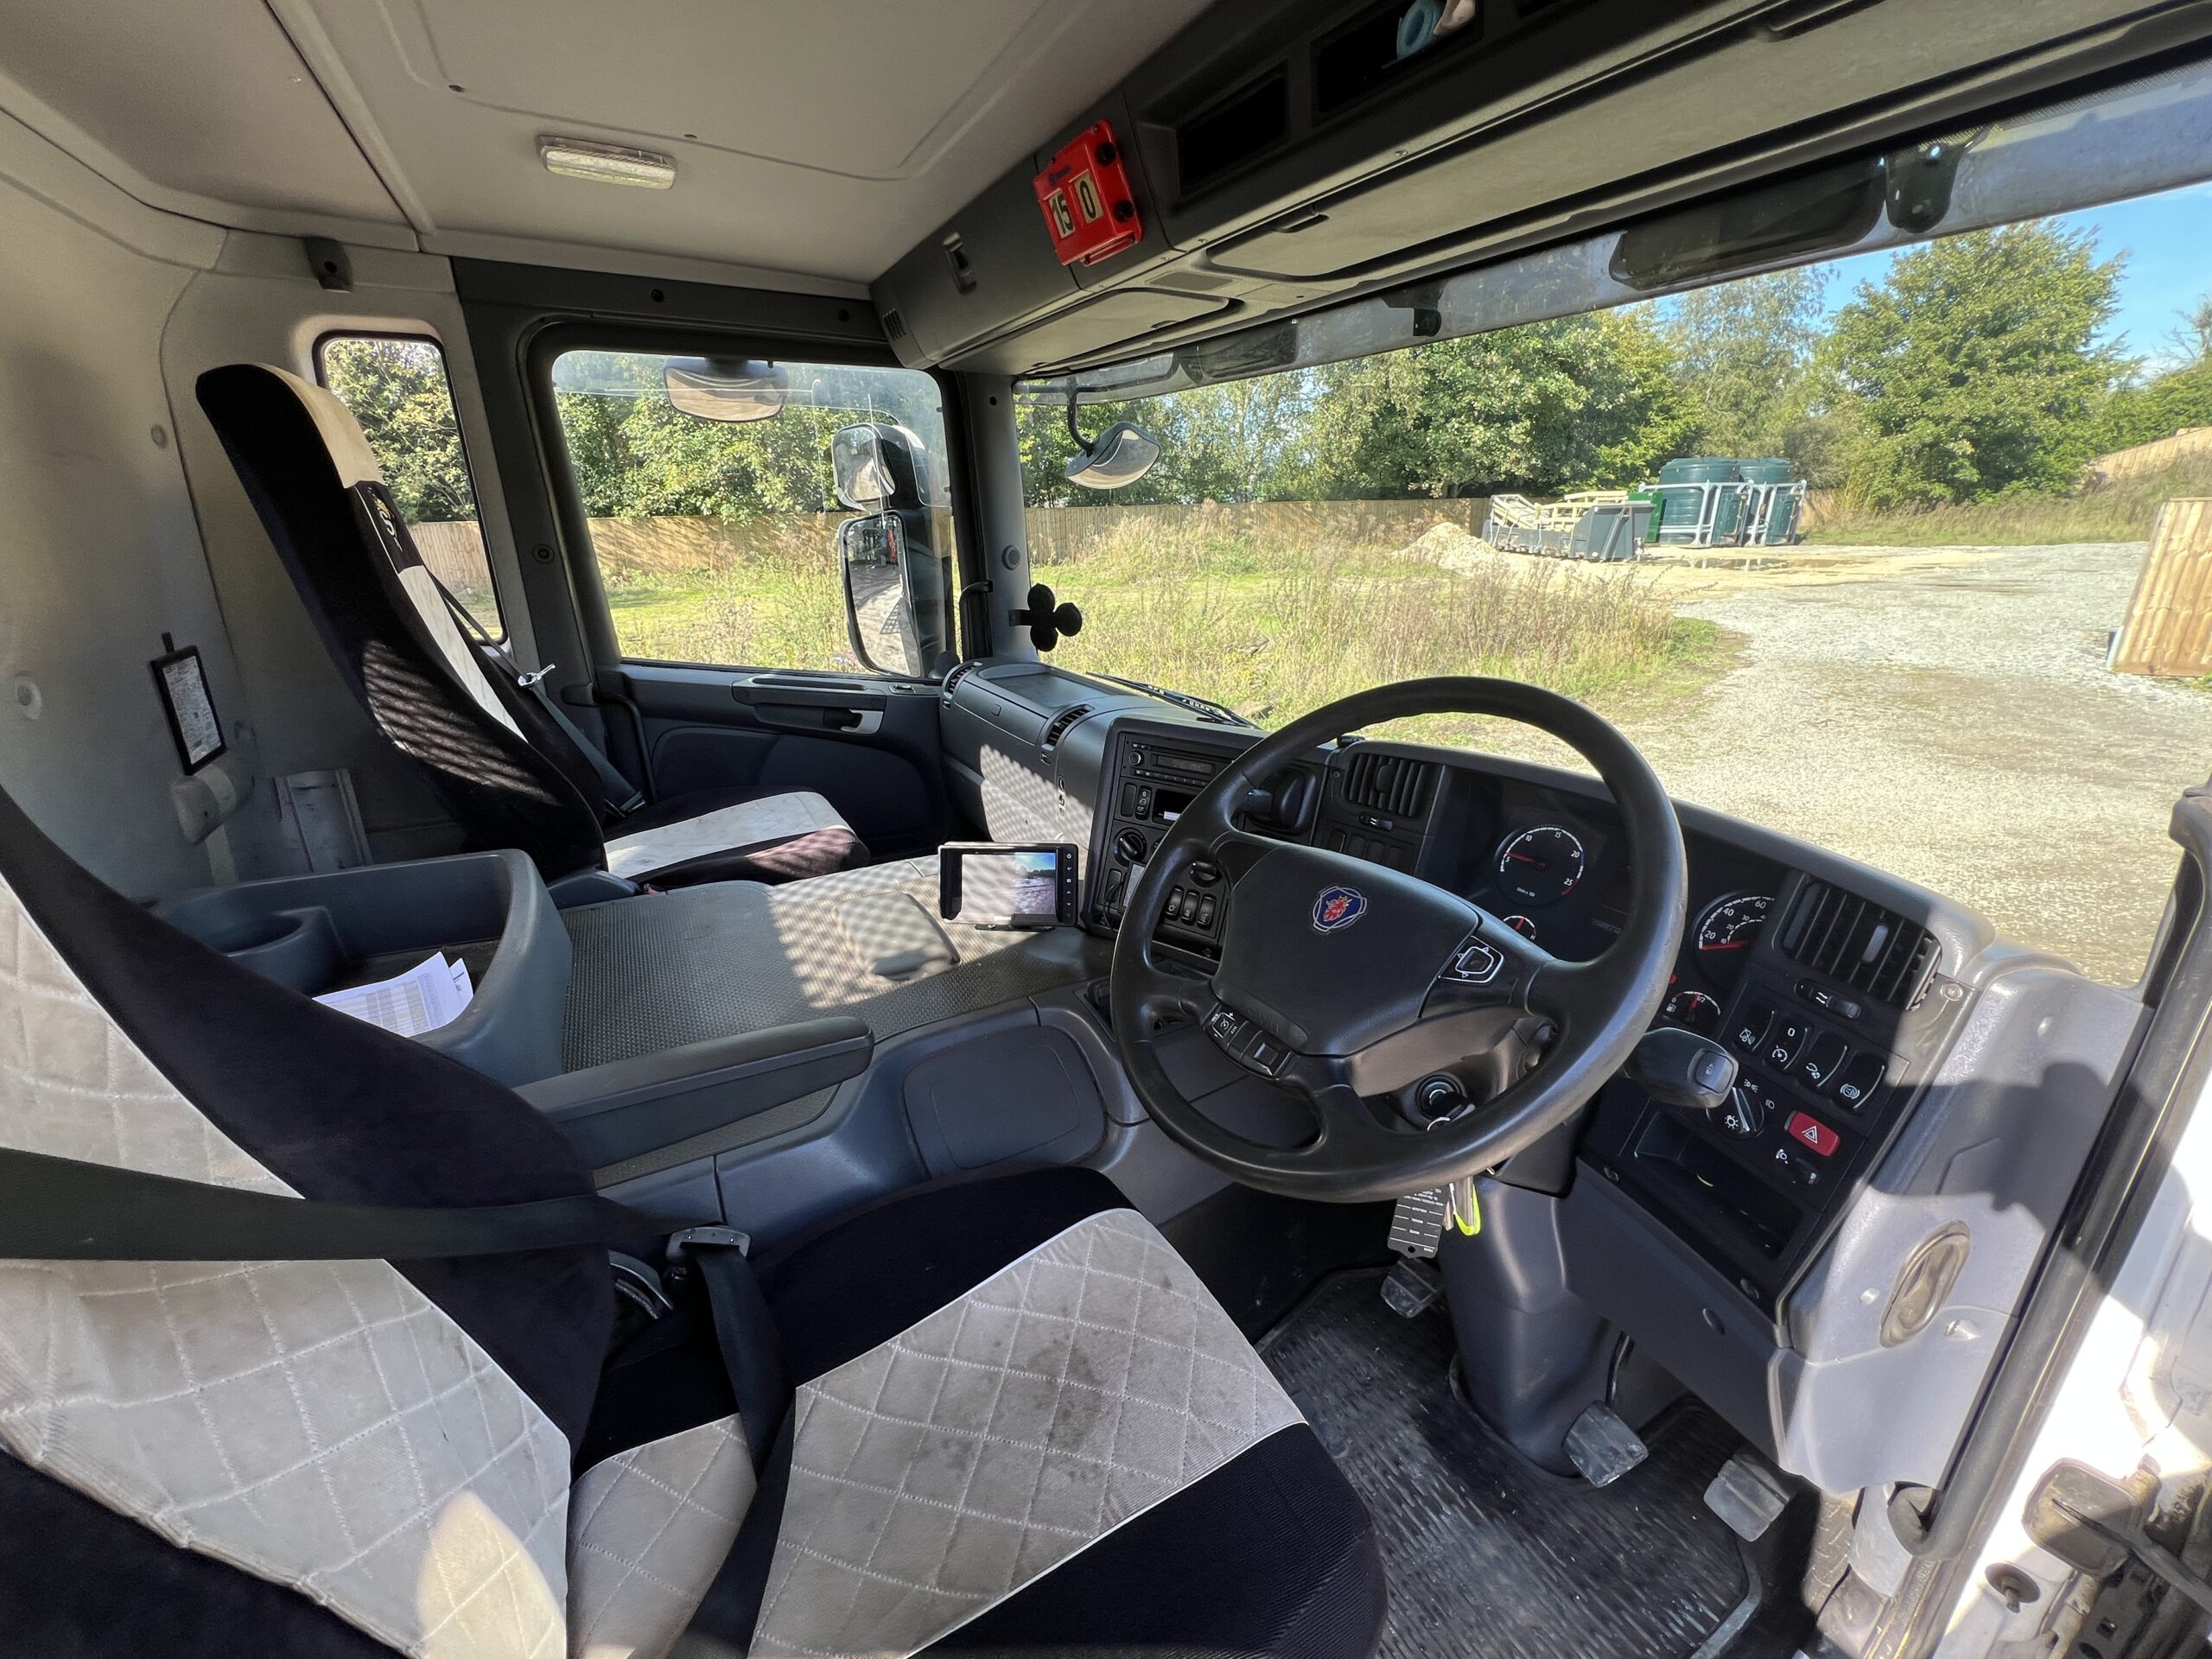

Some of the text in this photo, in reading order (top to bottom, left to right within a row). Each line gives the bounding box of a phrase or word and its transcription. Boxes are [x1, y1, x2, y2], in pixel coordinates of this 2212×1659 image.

[1052, 180, 1096, 234] 15 0
[1755, 900, 1767, 909] 60
[1723, 907, 1734, 916] 40
[1705, 931, 1716, 939] 20
